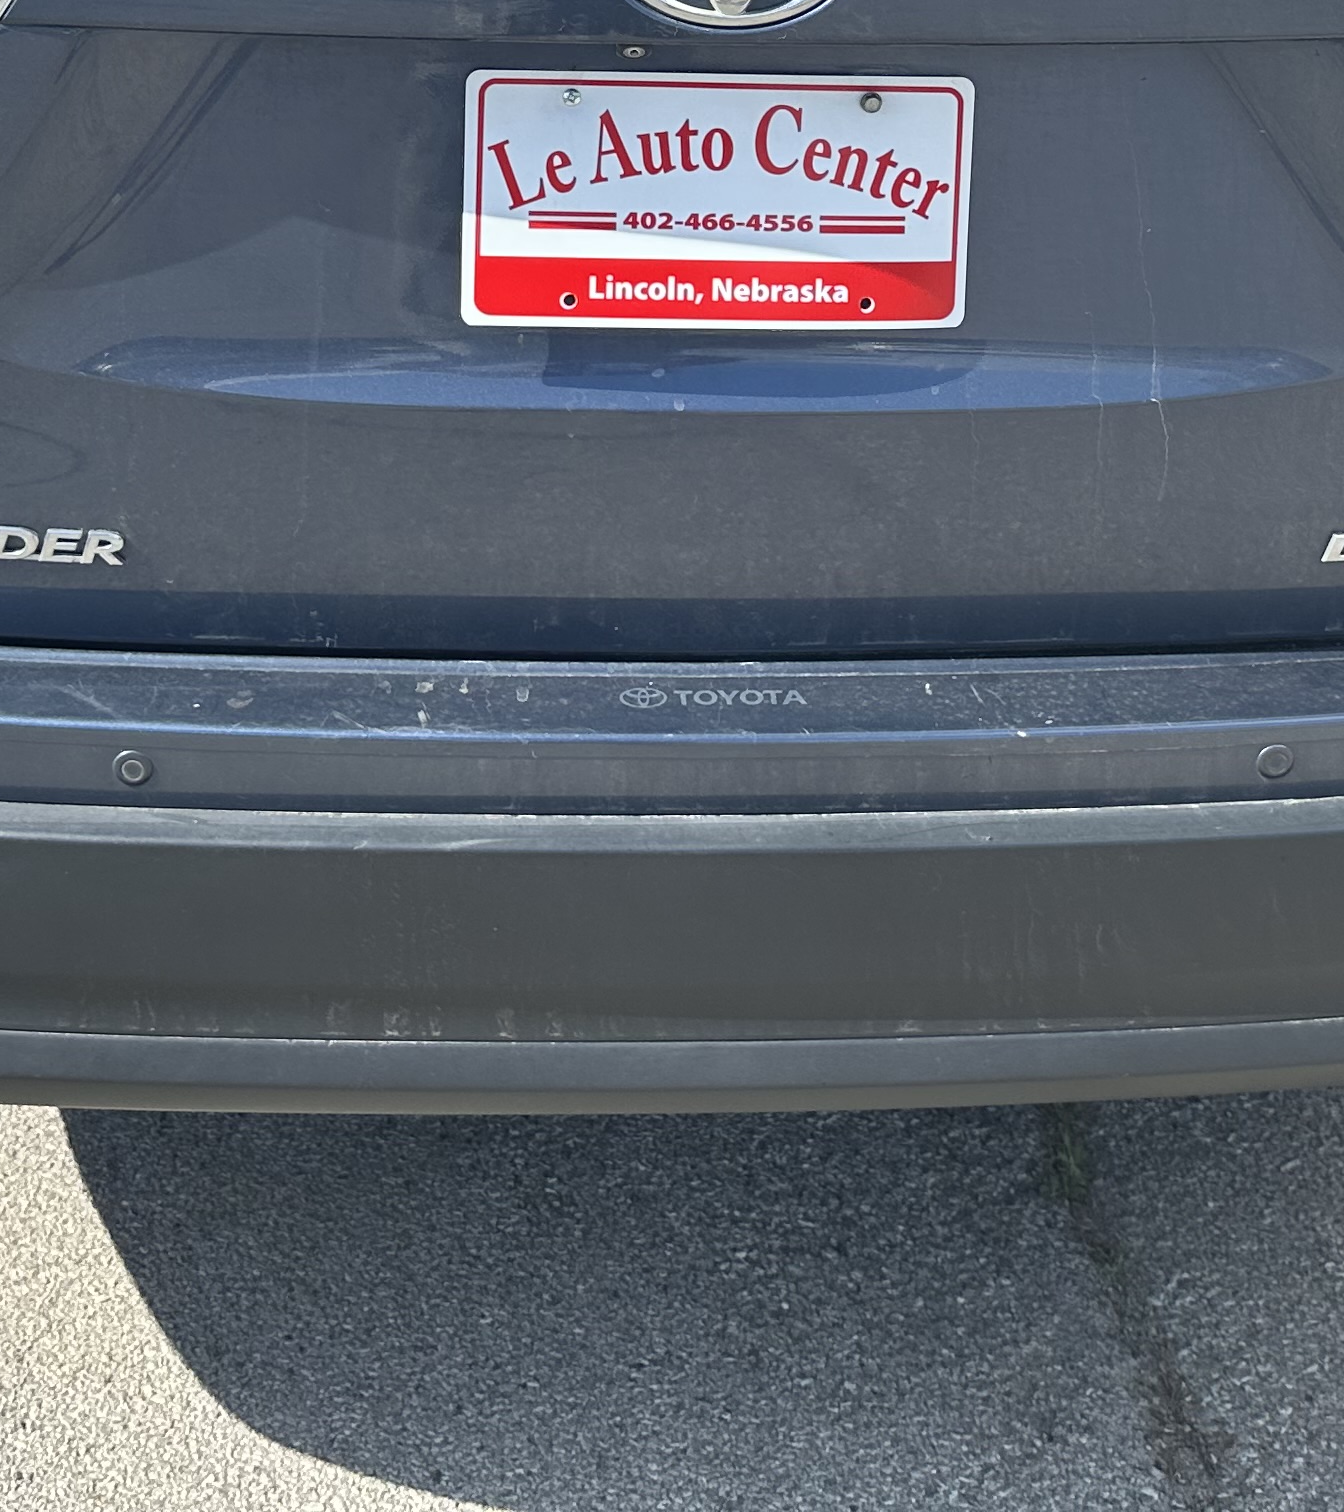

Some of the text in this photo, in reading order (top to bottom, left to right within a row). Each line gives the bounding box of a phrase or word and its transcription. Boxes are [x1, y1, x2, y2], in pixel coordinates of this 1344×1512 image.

[488, 104, 949, 220] Le Auto Center
[623, 211, 814, 233] 402-466-4556
[588, 275, 849, 305] Lincoln, Nebraska
[673, 689, 808, 705] TOYOTA
